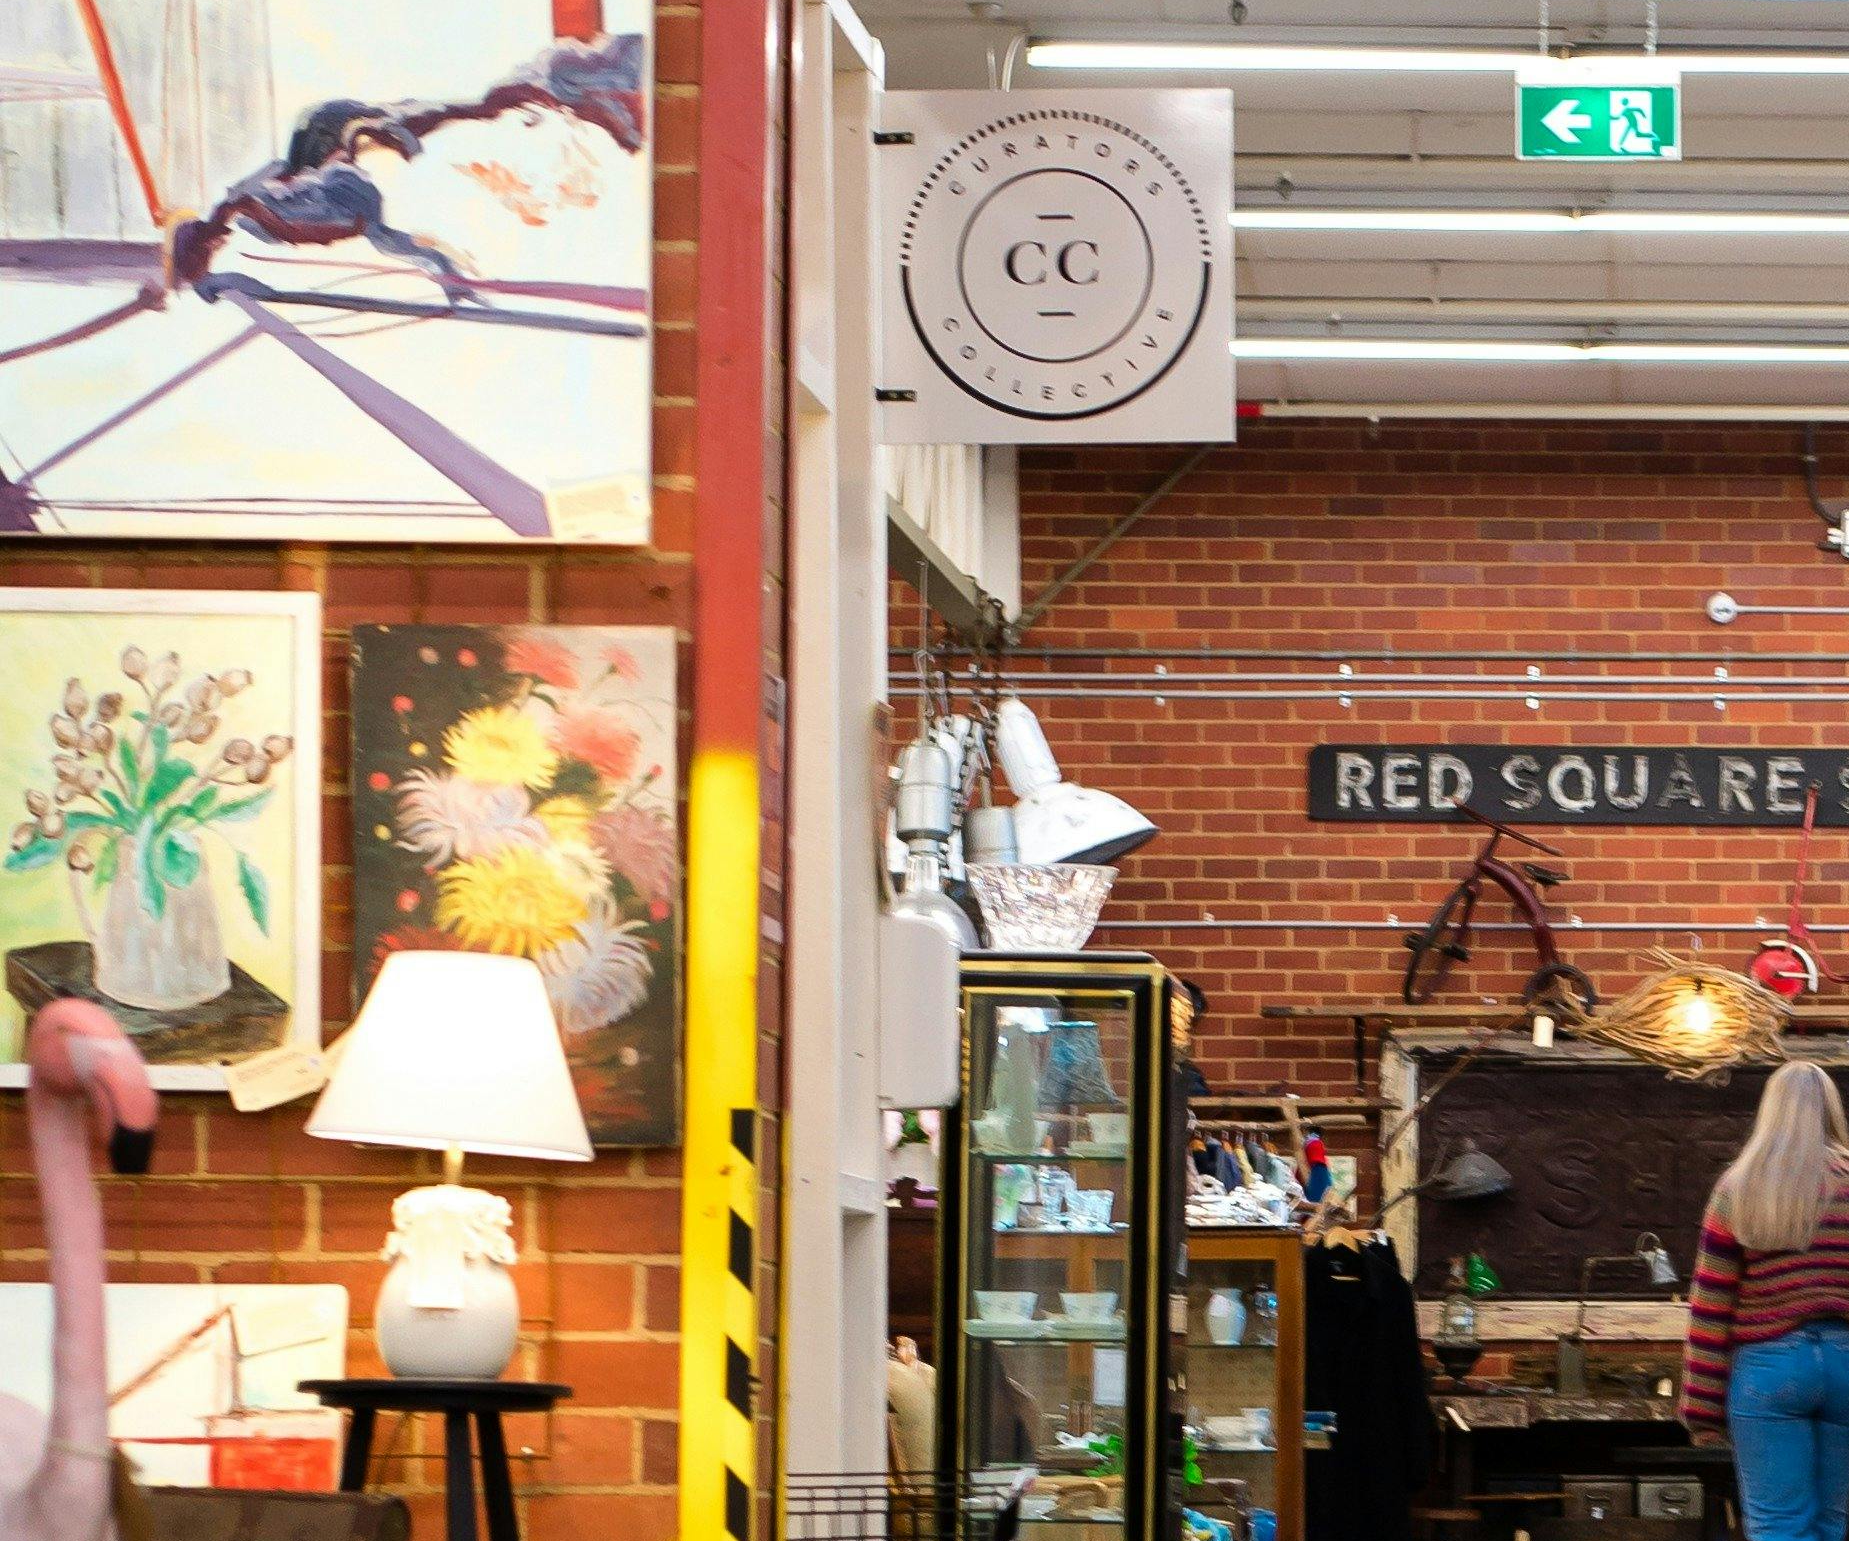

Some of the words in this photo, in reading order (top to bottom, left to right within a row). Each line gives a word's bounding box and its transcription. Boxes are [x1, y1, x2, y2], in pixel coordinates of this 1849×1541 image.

[948, 134, 1164, 197] CURATORS
[1004, 239, 1100, 285] CC
[942, 308, 1174, 401] COLLECTIVE
[1335, 752, 1474, 811] RED
[1500, 753, 1804, 813] SQUARE
